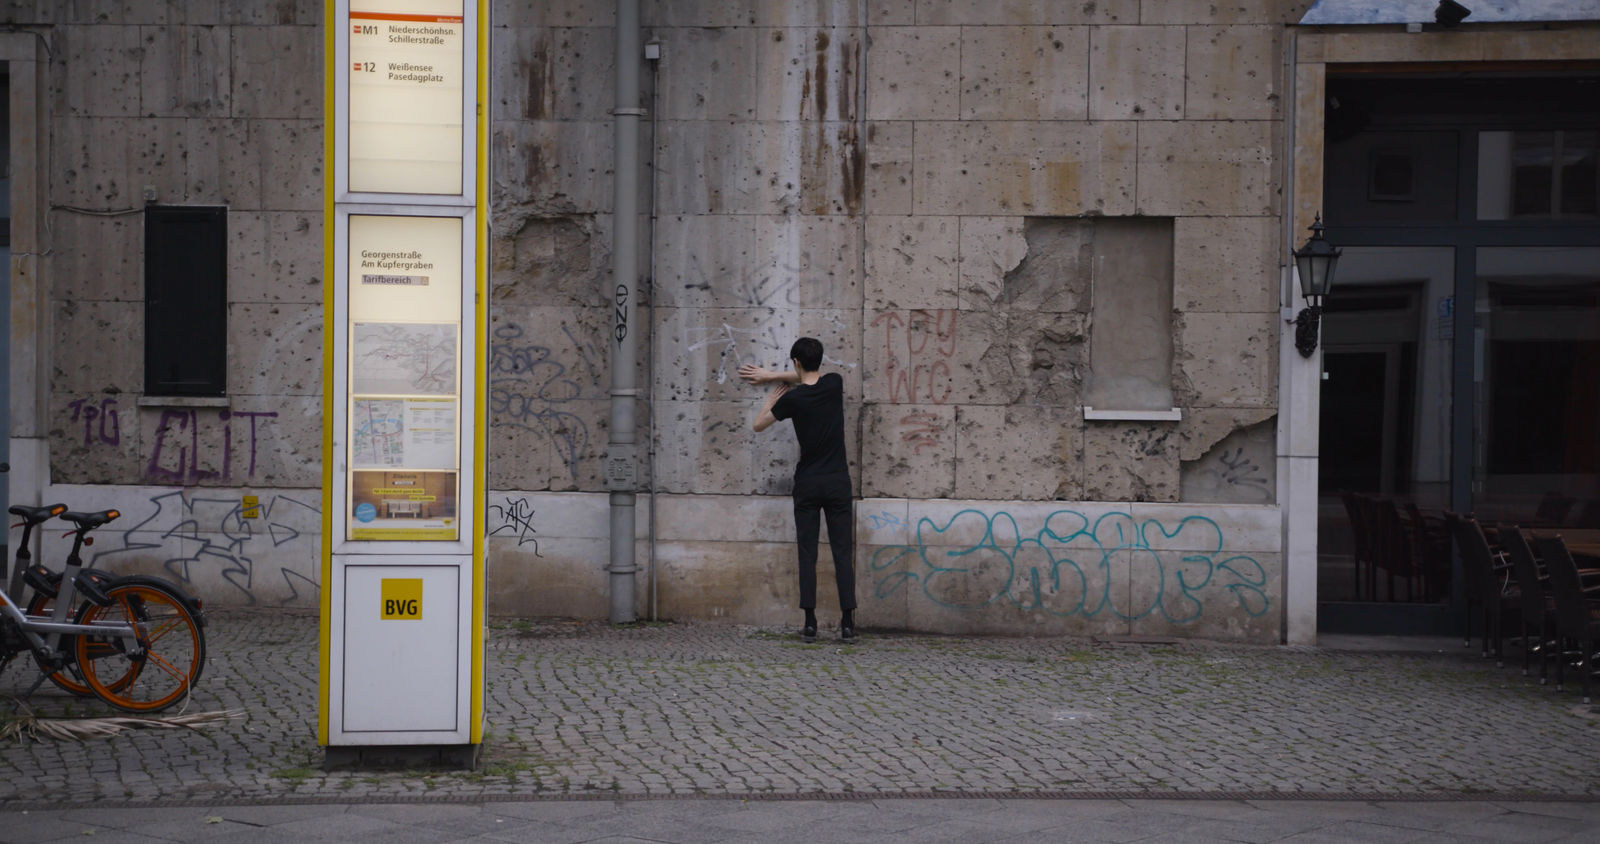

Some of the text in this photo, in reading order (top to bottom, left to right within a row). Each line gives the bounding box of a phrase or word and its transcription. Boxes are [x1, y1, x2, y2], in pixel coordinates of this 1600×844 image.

[362, 25, 379, 35] M1
[388, 35, 445, 45] Schillerstraße
[363, 62, 434, 73] 12 Weißensee
[388, 72, 444, 83] Pasedagplatz
[361, 250, 422, 260] Georgenstraße
[361, 260, 434, 270] Am Kupfergraben
[362, 275, 412, 284] Tarifbereich
[385, 599, 418, 616] BVG
